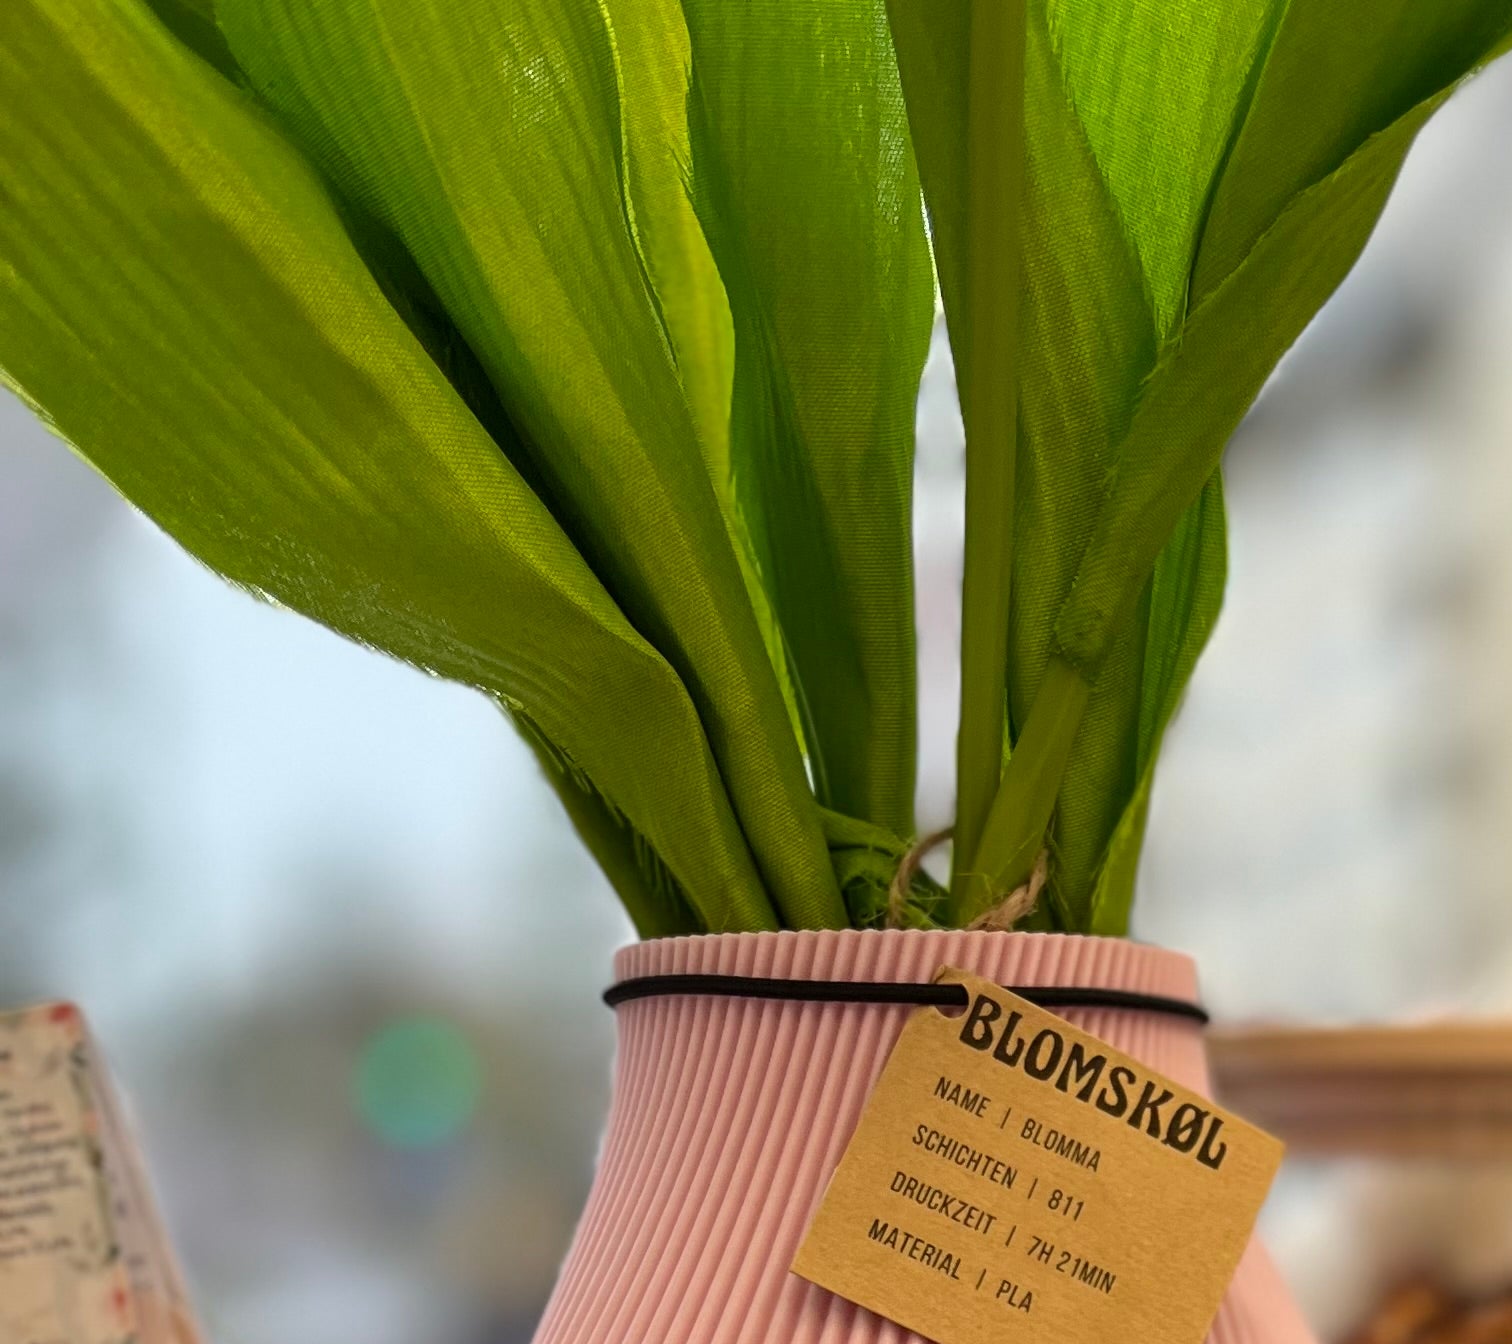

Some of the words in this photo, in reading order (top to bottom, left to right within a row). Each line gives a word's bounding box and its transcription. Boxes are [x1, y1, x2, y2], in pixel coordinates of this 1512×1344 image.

[933, 1076, 992, 1118] NAME
[1020, 1118, 1101, 1173] BLOMMA
[959, 993, 1228, 1171] BLOMSKØL
[912, 1124, 1018, 1190] SCHICHTEN
[1047, 1189, 1085, 1222] 811
[867, 1218, 962, 1281] MATERIAL
[996, 1279, 1034, 1313] PLA
[890, 1171, 998, 1235] DRUCKZEIT
[1027, 1235, 1055, 1265] 7H
[1056, 1251, 1117, 1295] 21MIN
